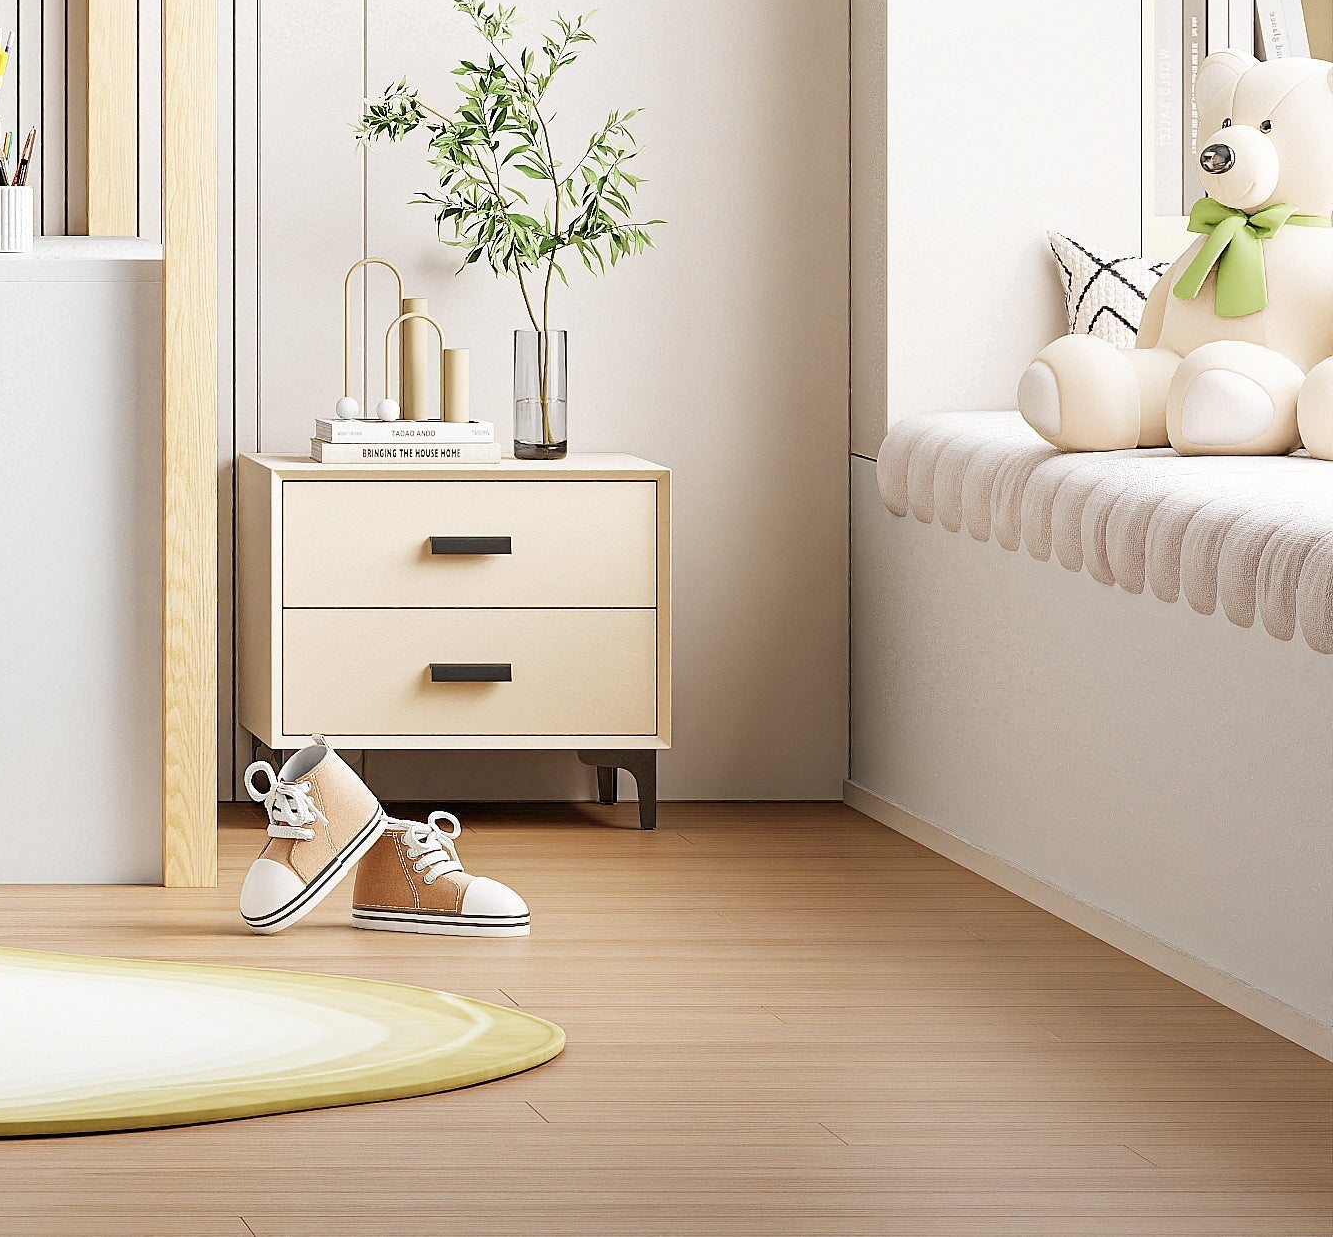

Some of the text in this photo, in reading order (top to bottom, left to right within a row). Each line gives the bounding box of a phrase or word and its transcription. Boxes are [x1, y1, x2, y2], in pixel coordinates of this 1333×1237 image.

[362, 449, 461, 458] BRINGING THE HOUSE HOME
